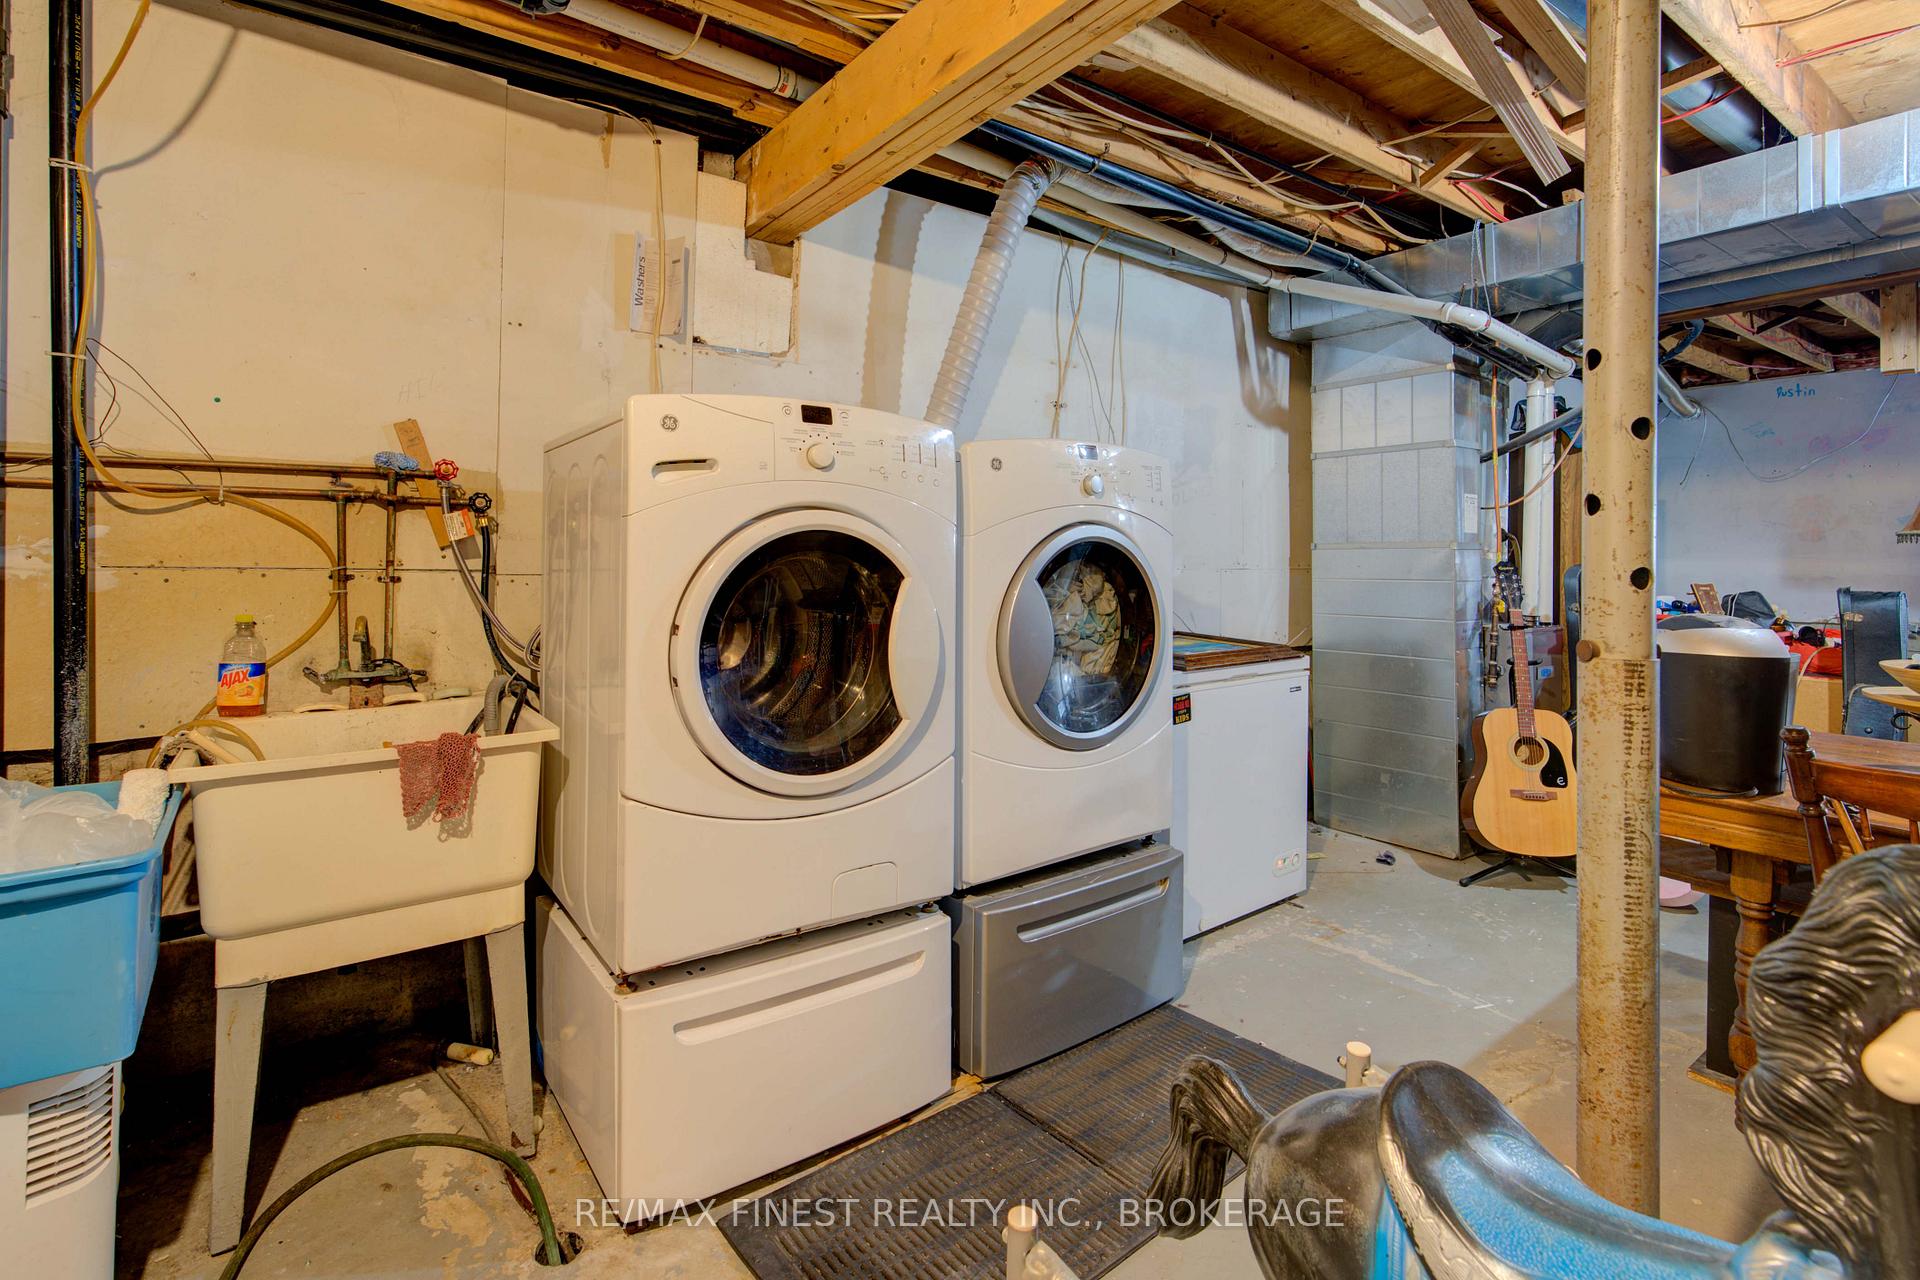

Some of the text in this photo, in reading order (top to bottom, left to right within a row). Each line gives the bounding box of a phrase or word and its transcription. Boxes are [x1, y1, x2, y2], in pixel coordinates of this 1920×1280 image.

[635, 256, 646, 306] Washers
[79, 541, 87, 575] CANRON
[220, 667, 249, 689] AJAX
